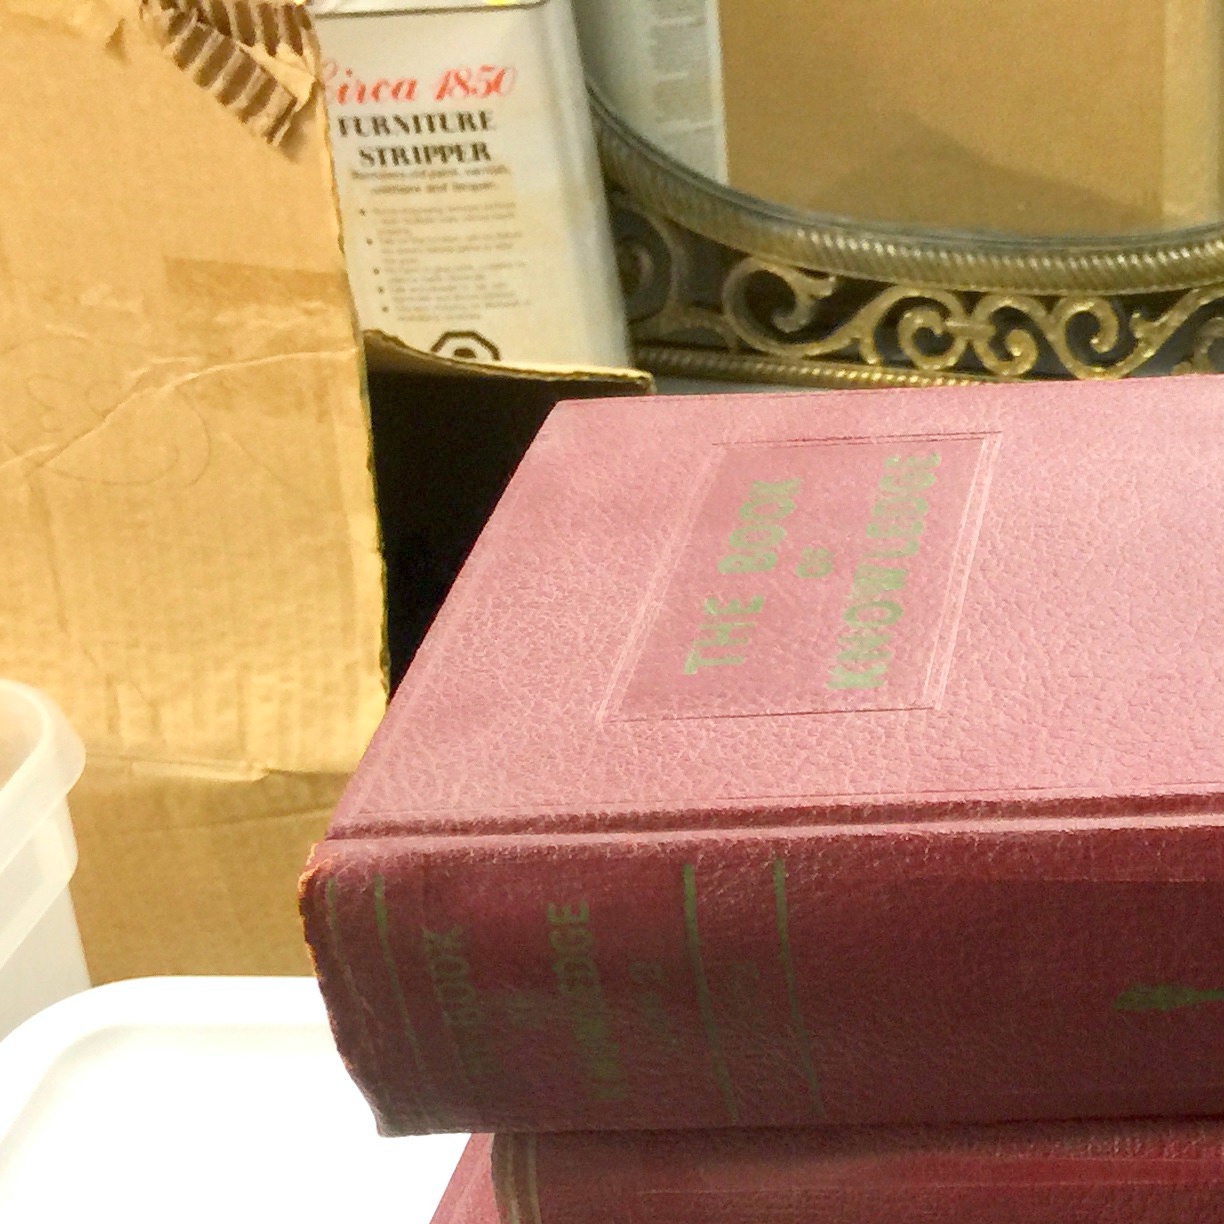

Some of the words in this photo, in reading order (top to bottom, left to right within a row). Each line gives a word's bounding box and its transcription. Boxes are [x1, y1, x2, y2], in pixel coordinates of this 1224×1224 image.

[434, 64, 517, 103] 1850
[337, 109, 497, 138] FURNITURE
[358, 141, 492, 168] STRIPPER
[718, 477, 801, 575] BOOK
[825, 452, 941, 690] KNOWLEDGE
[683, 595, 766, 676] THE
